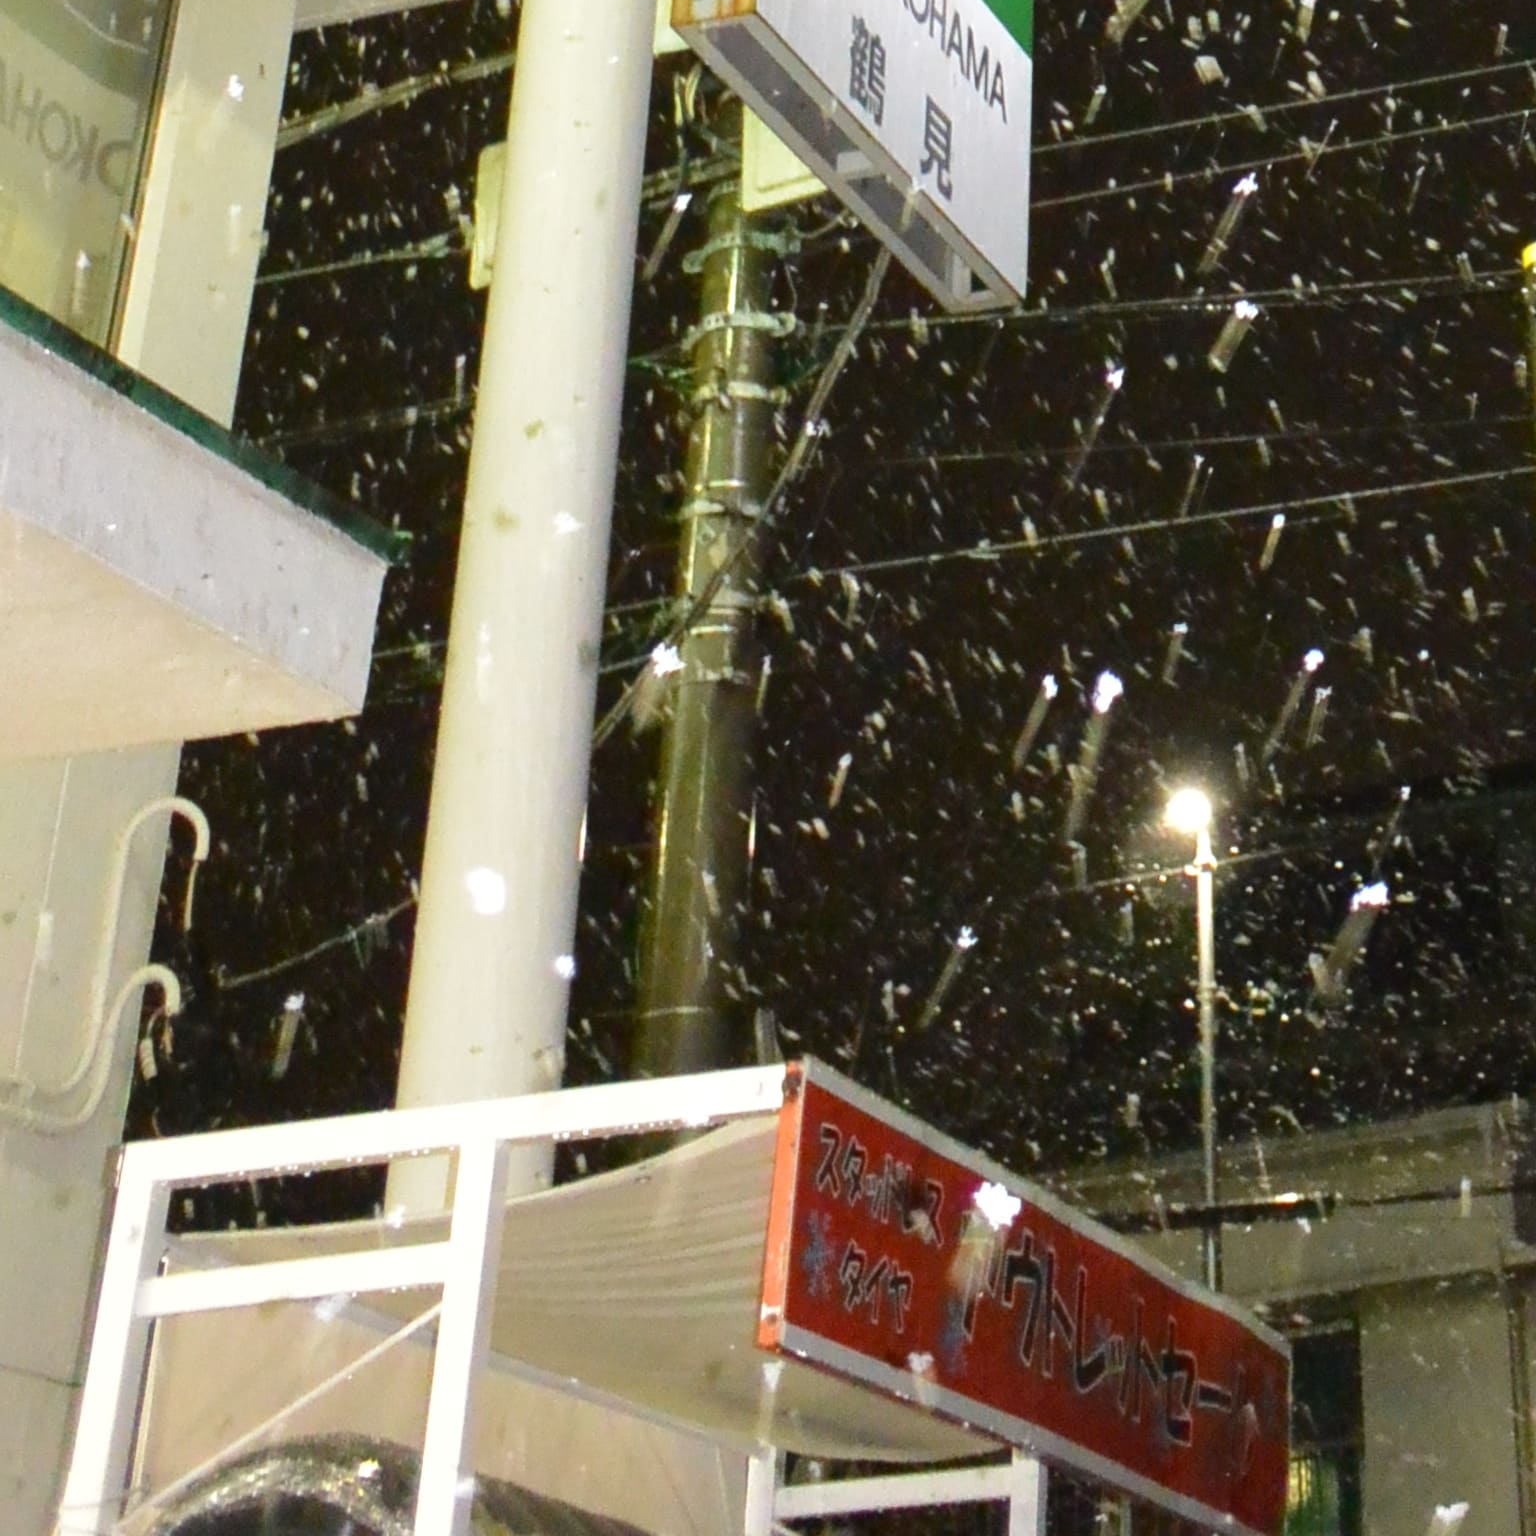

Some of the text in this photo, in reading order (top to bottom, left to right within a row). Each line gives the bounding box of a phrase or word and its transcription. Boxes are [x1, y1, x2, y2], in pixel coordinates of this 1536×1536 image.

[849, 14, 953, 202] 鶴見
[839, 1236, 914, 1335] タイヤ
